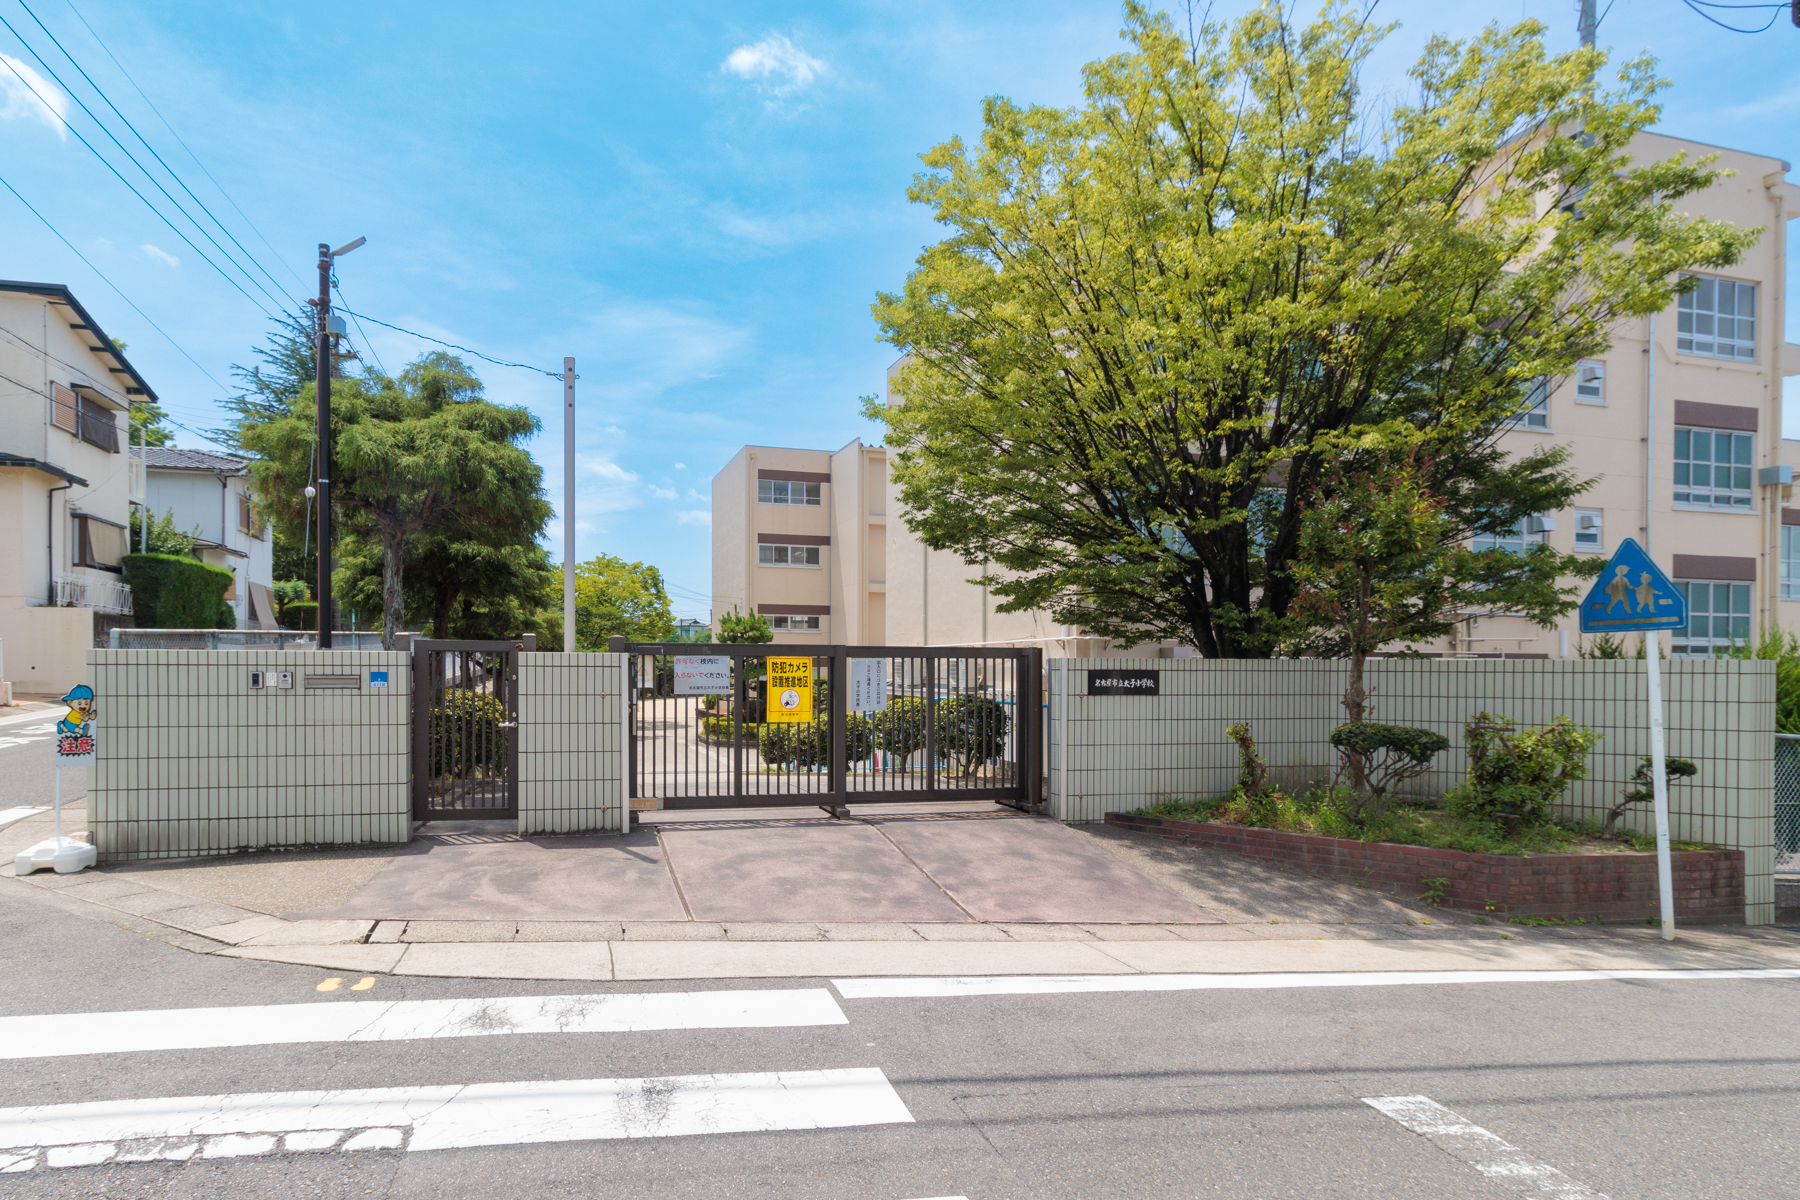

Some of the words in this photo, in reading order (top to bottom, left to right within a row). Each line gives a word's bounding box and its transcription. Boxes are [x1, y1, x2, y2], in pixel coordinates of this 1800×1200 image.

[675, 657, 719, 665] 許可なく校内に
[771, 661, 808, 674] 防犯カメラ
[674, 671, 730, 679] 入らないでください。
[771, 675, 809, 688] 設置推進地区
[1094, 678, 1155, 688] 名古屋市立太子小学校
[61, 738, 92, 754] 注意
